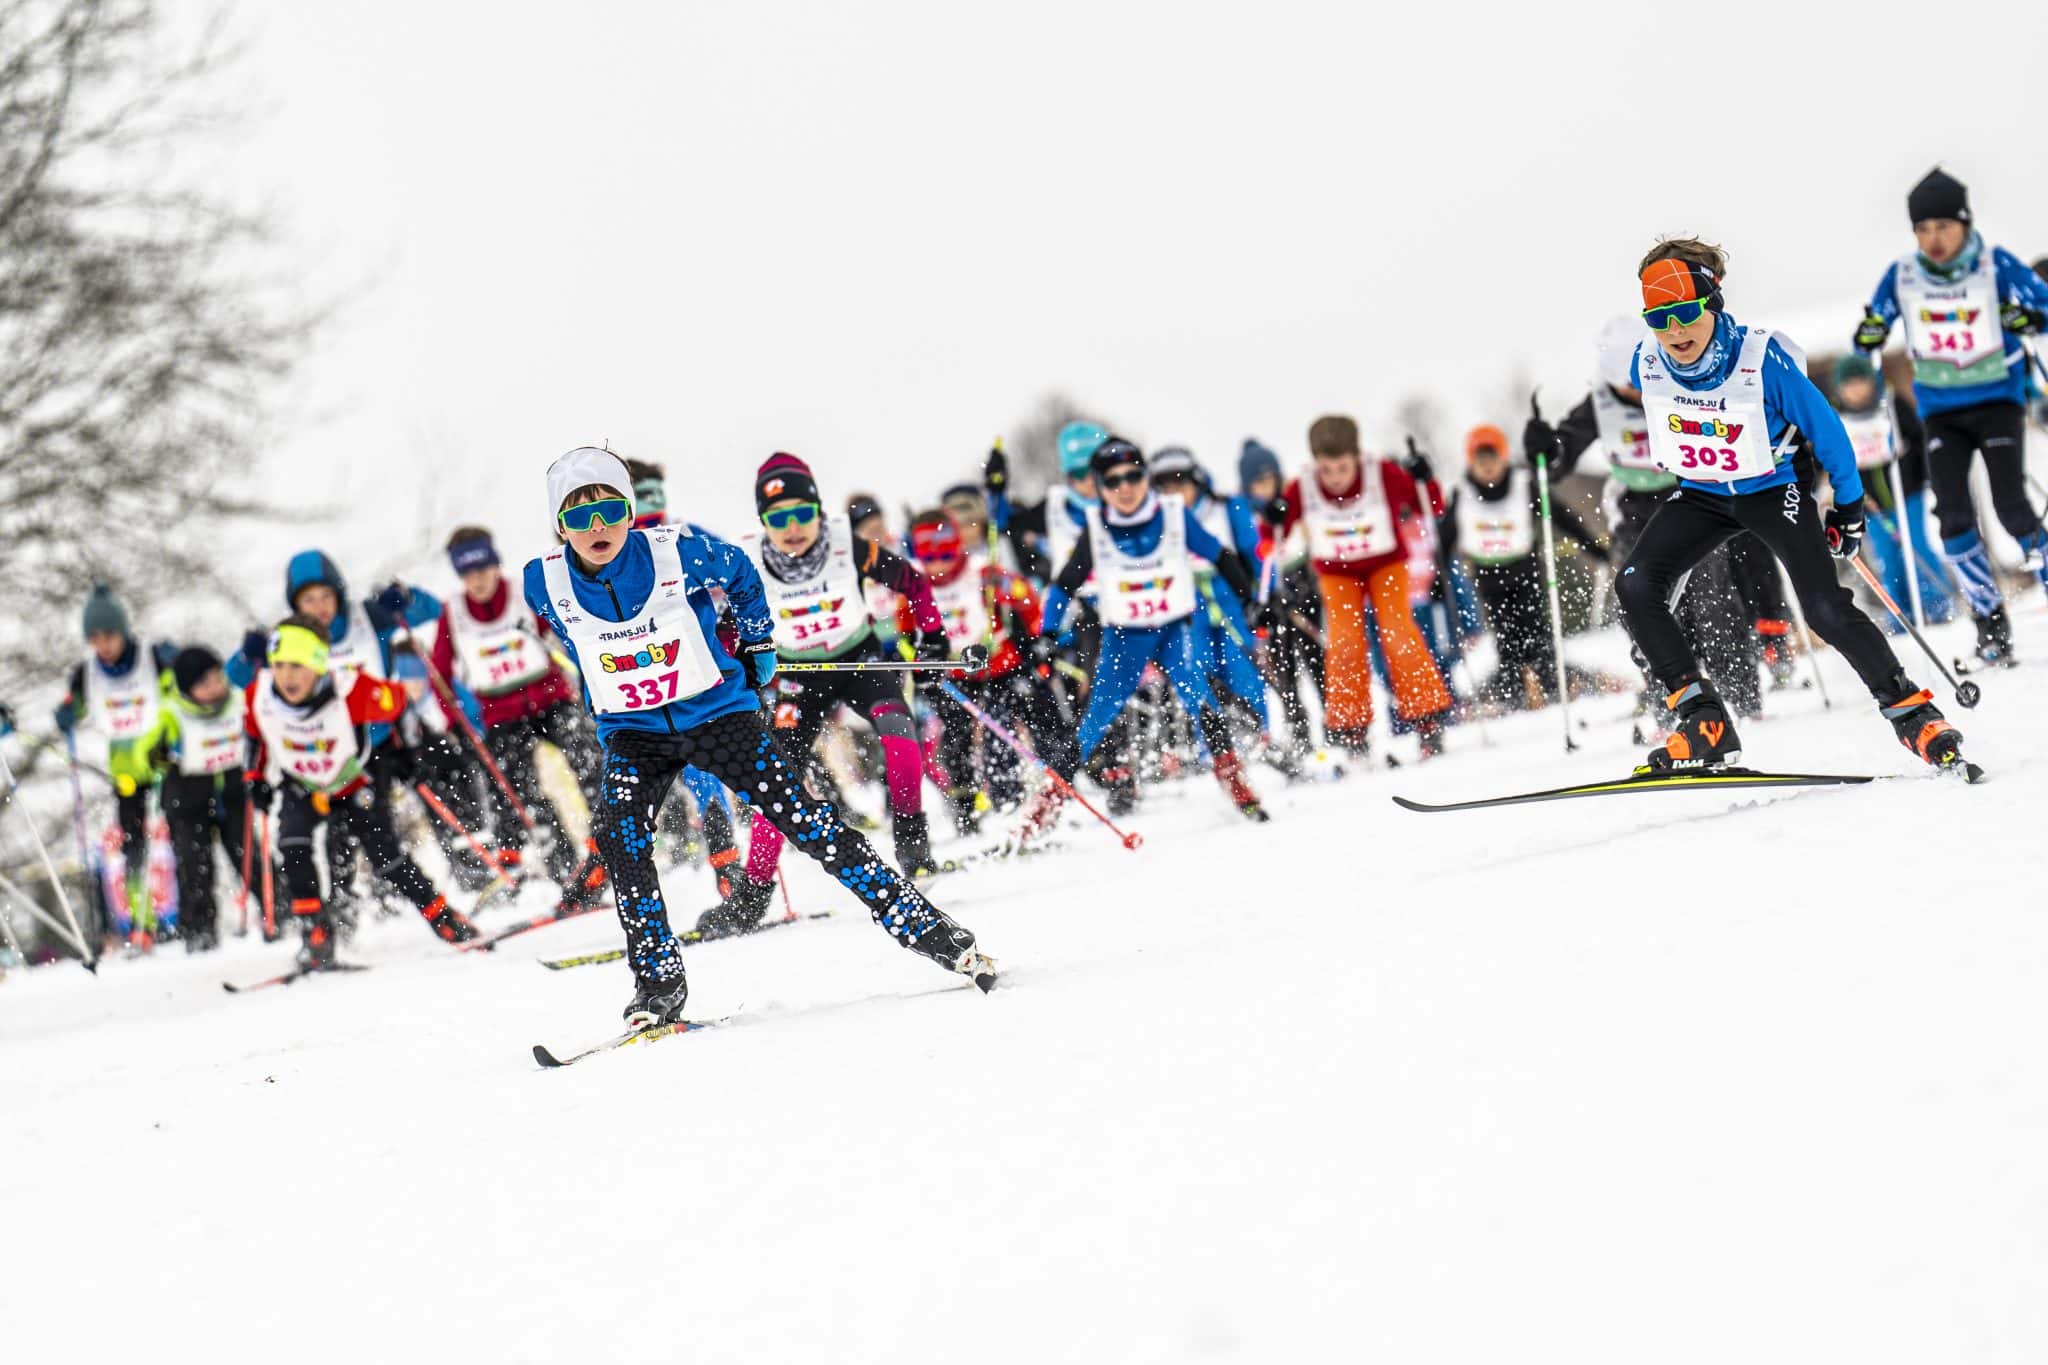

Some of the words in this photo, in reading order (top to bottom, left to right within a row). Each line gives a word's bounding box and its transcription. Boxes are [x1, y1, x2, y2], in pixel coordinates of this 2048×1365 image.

[1928, 331, 1974, 352] 343
[1668, 413, 1744, 444] Smoby
[1678, 444, 1739, 472] 303
[792, 617, 843, 640] 312
[599, 638, 680, 673] Smoby
[617, 670, 679, 708] 337
